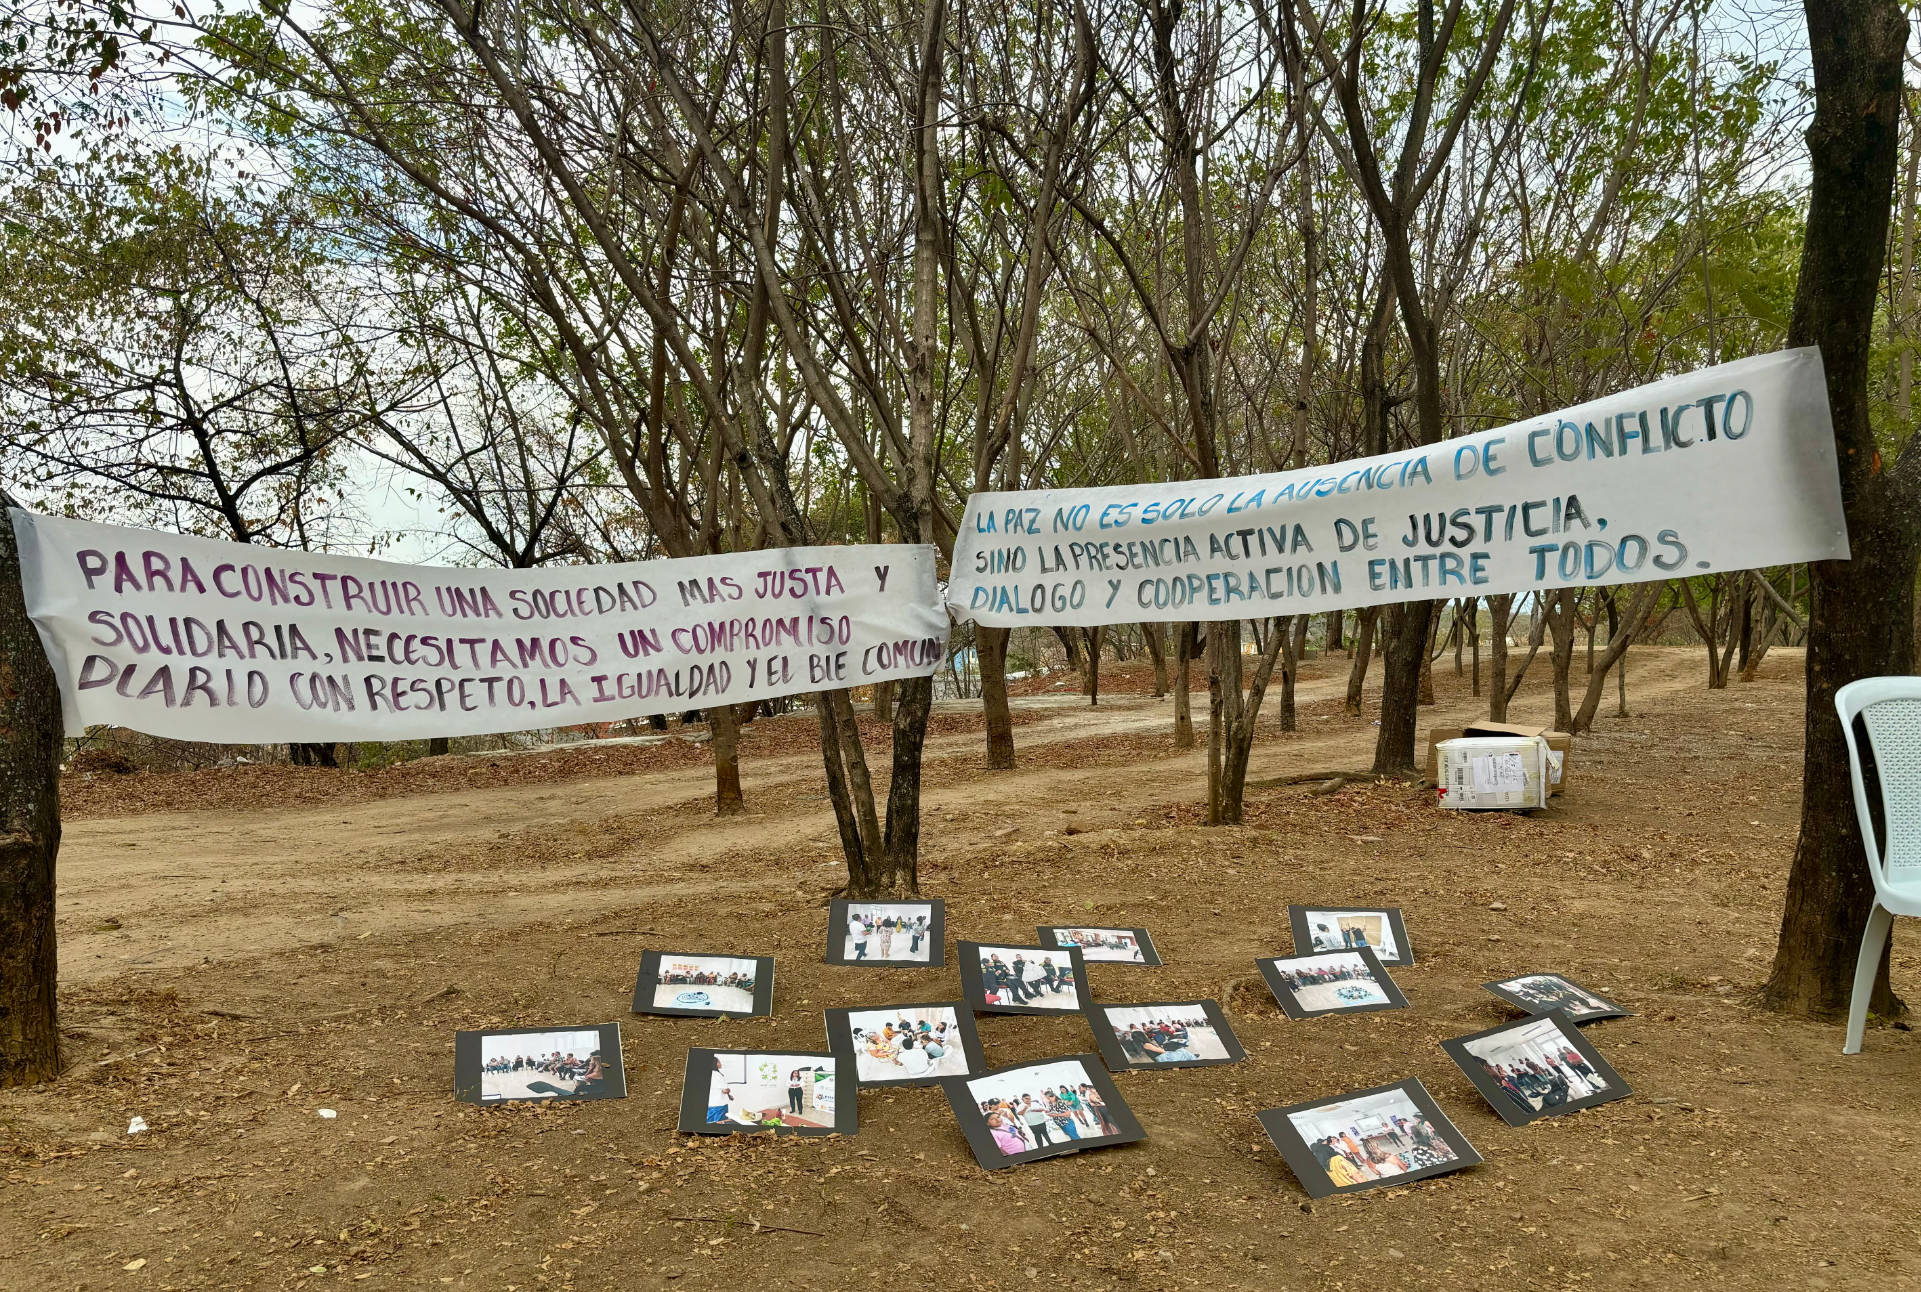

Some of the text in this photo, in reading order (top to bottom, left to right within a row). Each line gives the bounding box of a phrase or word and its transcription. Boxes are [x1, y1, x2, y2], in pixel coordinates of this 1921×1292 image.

[977, 510, 996, 533] LA
[1004, 508, 1041, 534] PAZ
[1053, 504, 1090, 532] NO
[1099, 503, 1138, 529] ES
[1141, 493, 1224, 524] SOLO
[1227, 489, 1266, 514] LA
[1454, 438, 1507, 481] DE
[970, 529, 1711, 614] DIALOGO Y COOPERACION ENTRE TODOS.
[976, 495, 1608, 574] SINO LA PRESENCIA ACTIVA DE JUSTICIA,
[77, 549, 889, 620] PARA CONSTRUIR UNA SOCIEDAD MAS JUSTA Y
[78, 636, 944, 712] DIARIO CON RESPETO, LA IGUALDAD Y EL BIE COMUN
[87, 610, 850, 670] SOLIDARIA, NECESITAMOS UN COMPROMISO
